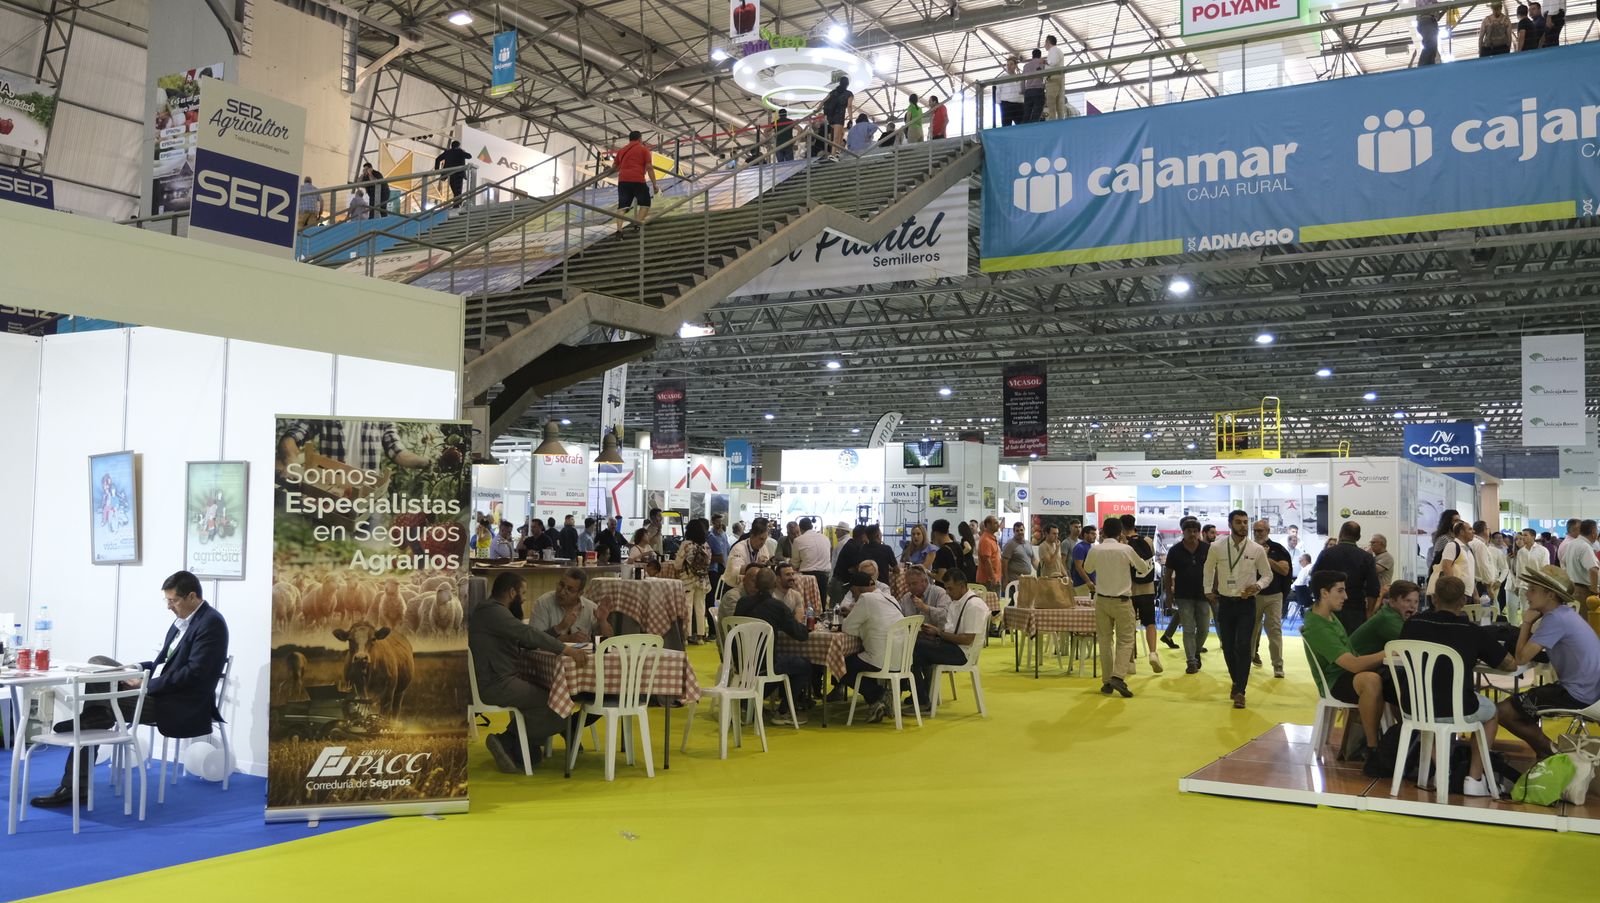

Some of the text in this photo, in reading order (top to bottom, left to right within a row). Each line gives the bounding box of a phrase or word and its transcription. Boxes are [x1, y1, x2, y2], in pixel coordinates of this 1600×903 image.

[1192, 0, 1280, 22] POLYANE
[226, 99, 262, 121] SER
[209, 109, 289, 140] Agricultor
[1087, 142, 1298, 204] cajamar
[196, 170, 290, 222] SER
[1187, 178, 1294, 201] CAJA RURAL
[815, 212, 945, 263] Pntel
[1198, 227, 1294, 252] ADNAGRO
[873, 251, 940, 268] Semilleros
[1009, 378, 1042, 387] VICASOL
[1408, 444, 1470, 457] CapGen
[286, 463, 377, 485] Somos
[286, 491, 461, 519] Especialistas
[1042, 497, 1070, 507] Olimpo
[1113, 504, 1120, 512] El
[1352, 508, 1386, 516] Guadalfeo
[313, 520, 460, 547] en Seguros
[350, 550, 460, 575] Agrarios
[346, 752, 431, 776] PACC
[355, 779, 367, 788] de
[370, 778, 411, 789] Seguros
